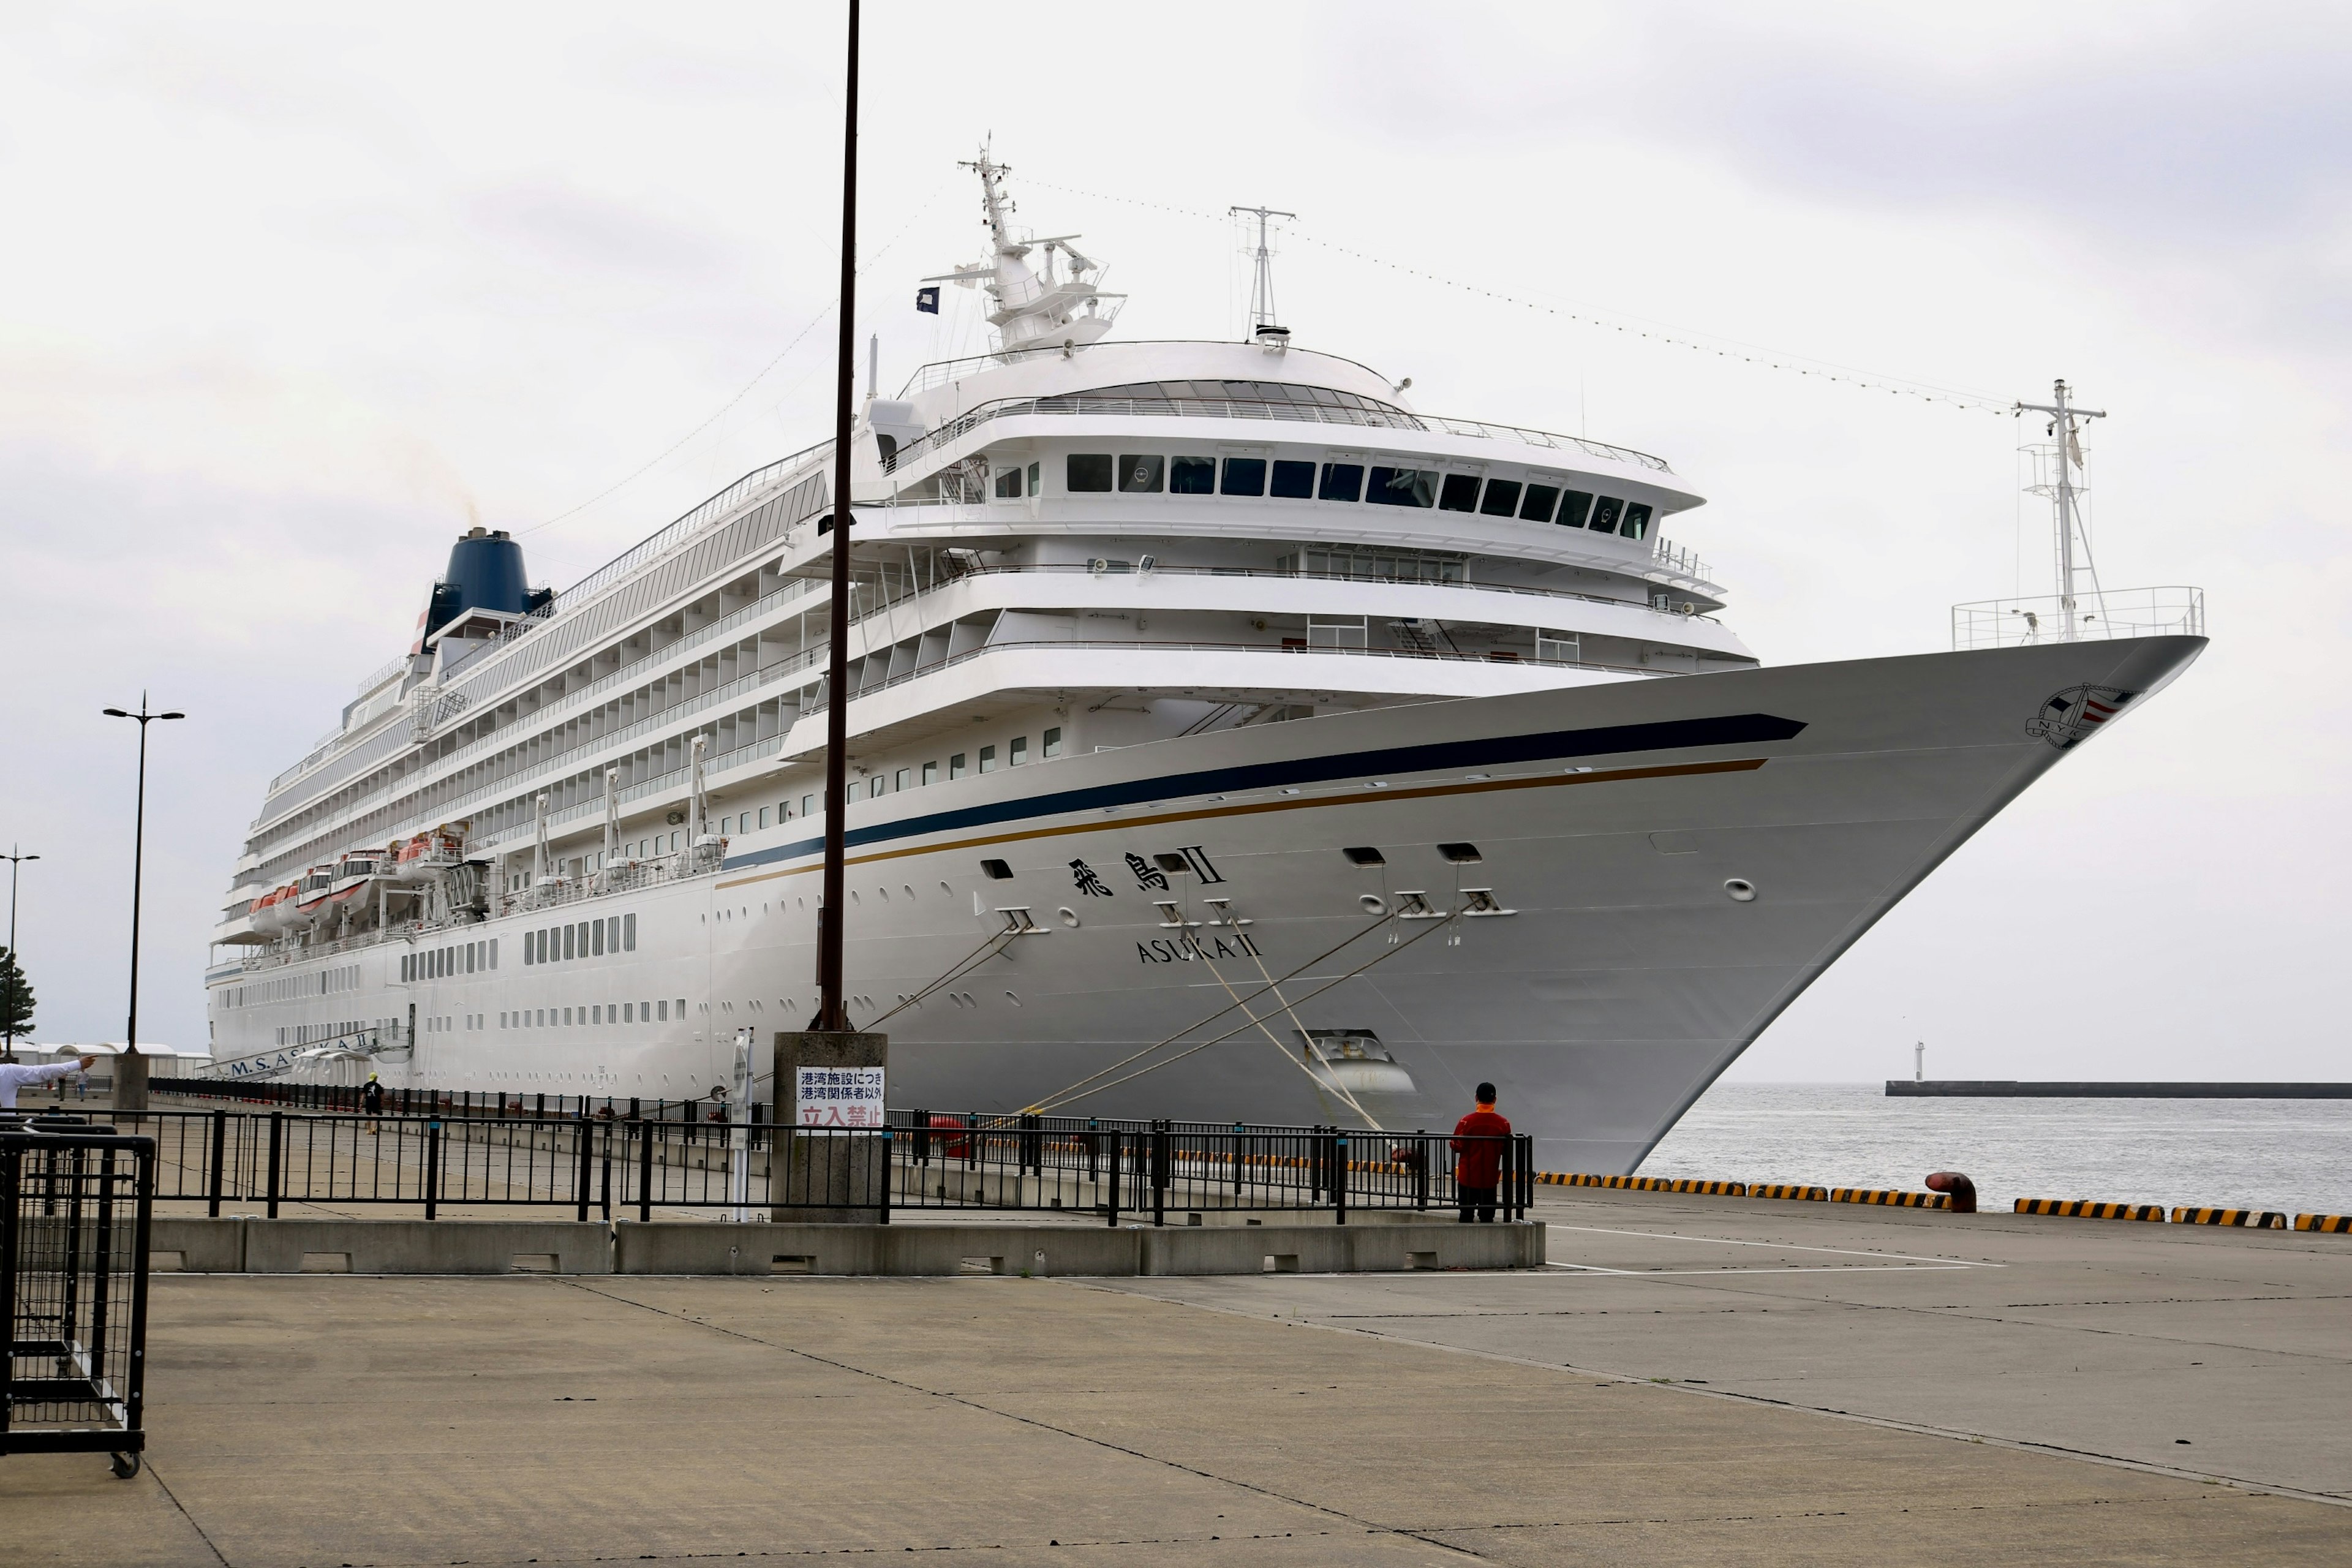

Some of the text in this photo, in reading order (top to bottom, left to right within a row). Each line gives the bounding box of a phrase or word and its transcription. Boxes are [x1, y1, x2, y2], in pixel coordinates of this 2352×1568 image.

[1136, 933, 1263, 963] ASUKA II
[356, 1033, 367, 1047] II
[802, 1072, 881, 1085] 港湾施設につき
[802, 1087, 881, 1099] 港湾関係者以外
[802, 1106, 881, 1126] 立入禁止
